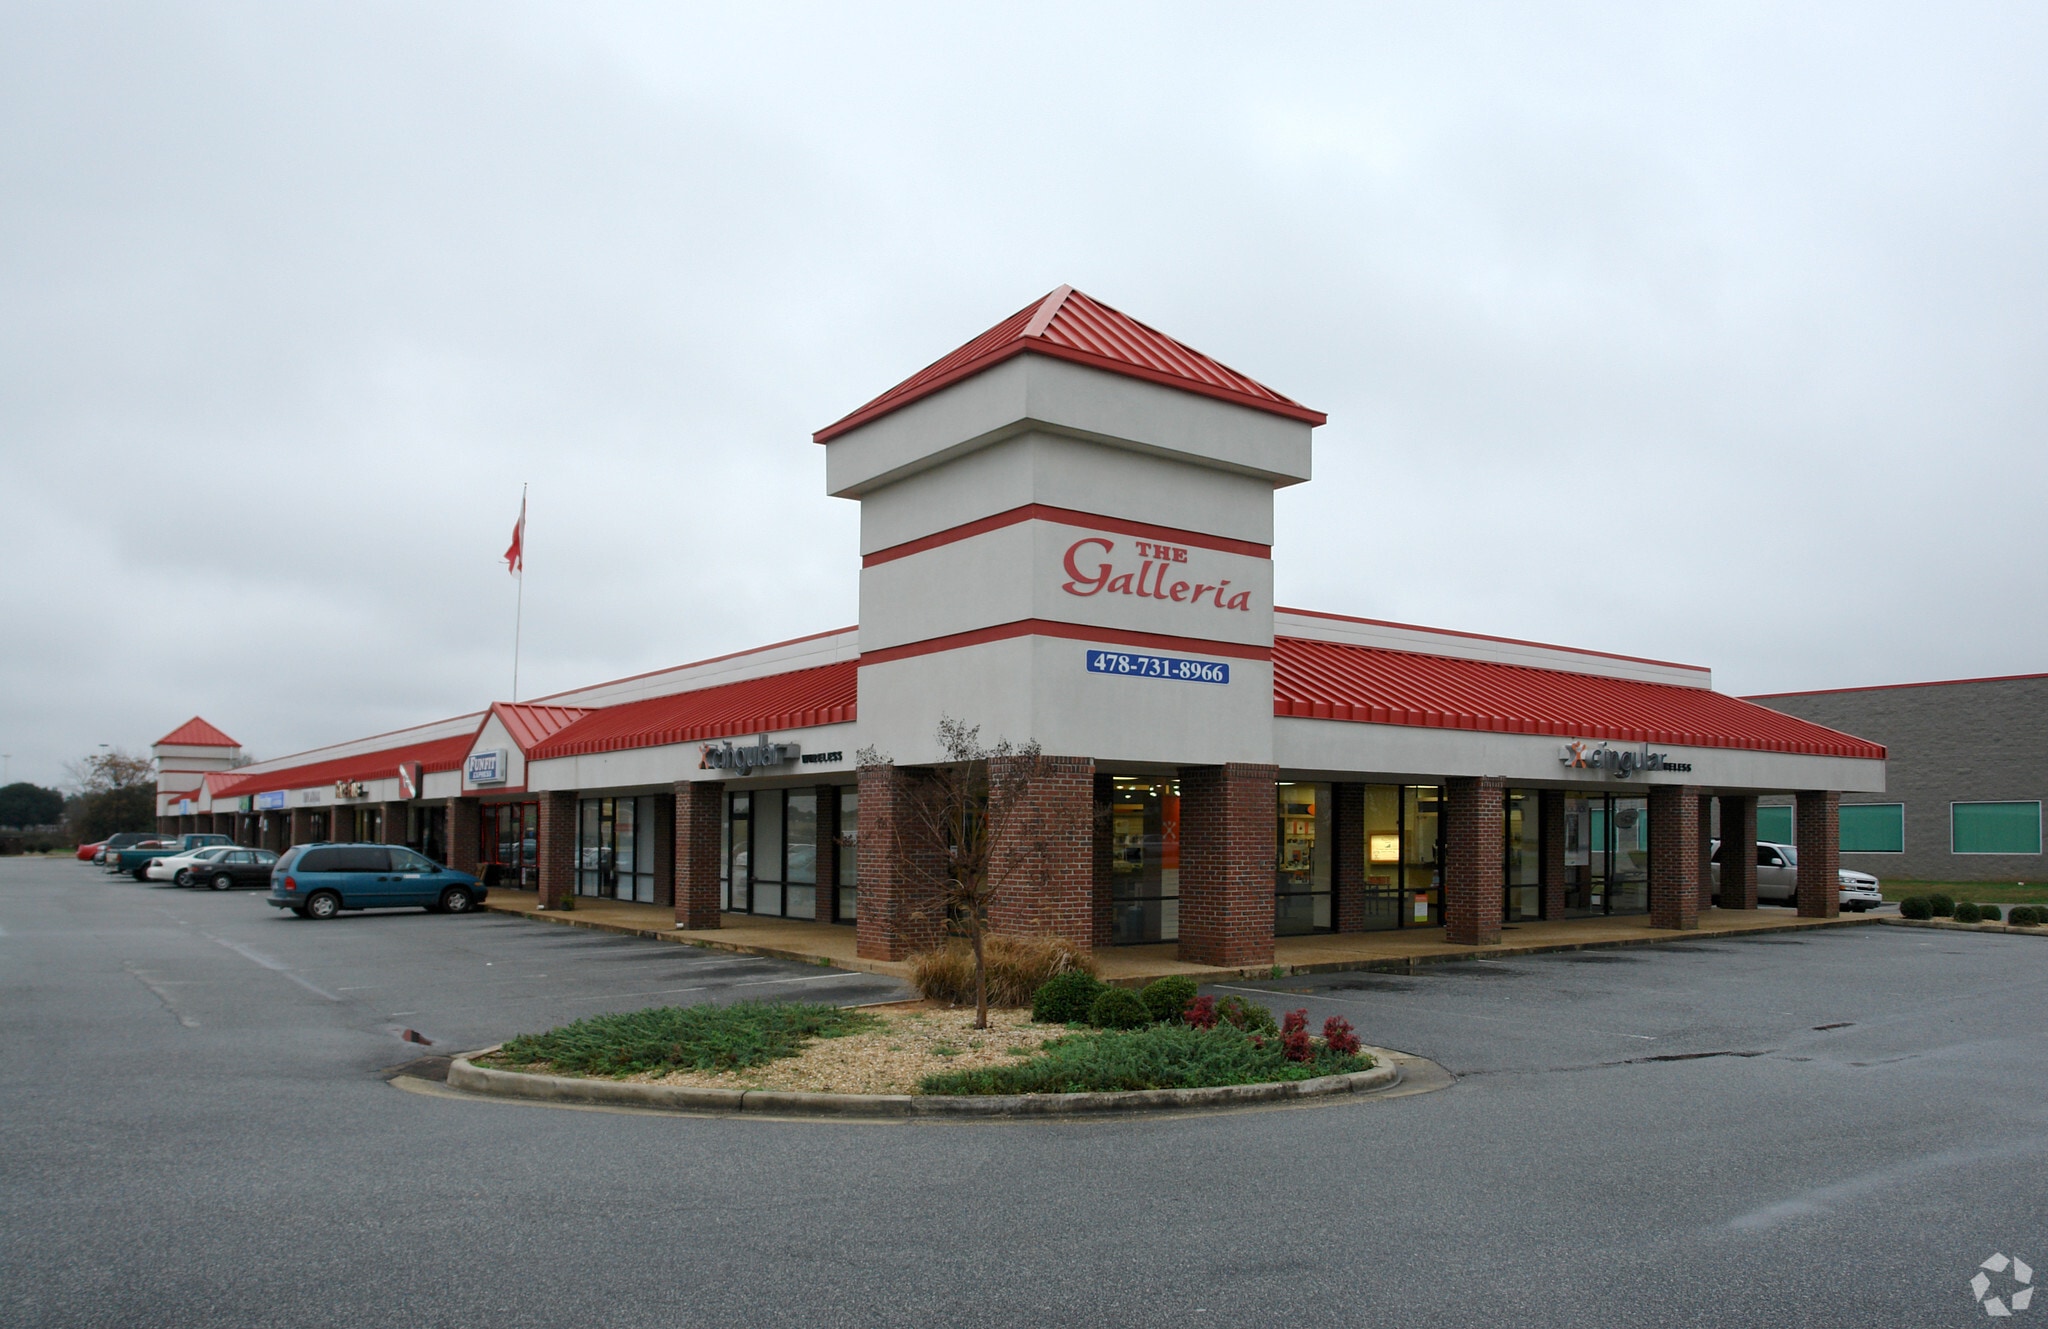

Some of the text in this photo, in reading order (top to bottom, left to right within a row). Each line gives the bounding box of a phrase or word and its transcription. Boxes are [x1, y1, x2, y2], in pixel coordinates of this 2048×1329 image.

[1135, 541, 1188, 563] THE
[1062, 537, 1251, 611] Galleria
[1093, 652, 1223, 682] 478-731-8966
[801, 751, 842, 763] WIRELESS
[1586, 741, 1667, 778] cingular
